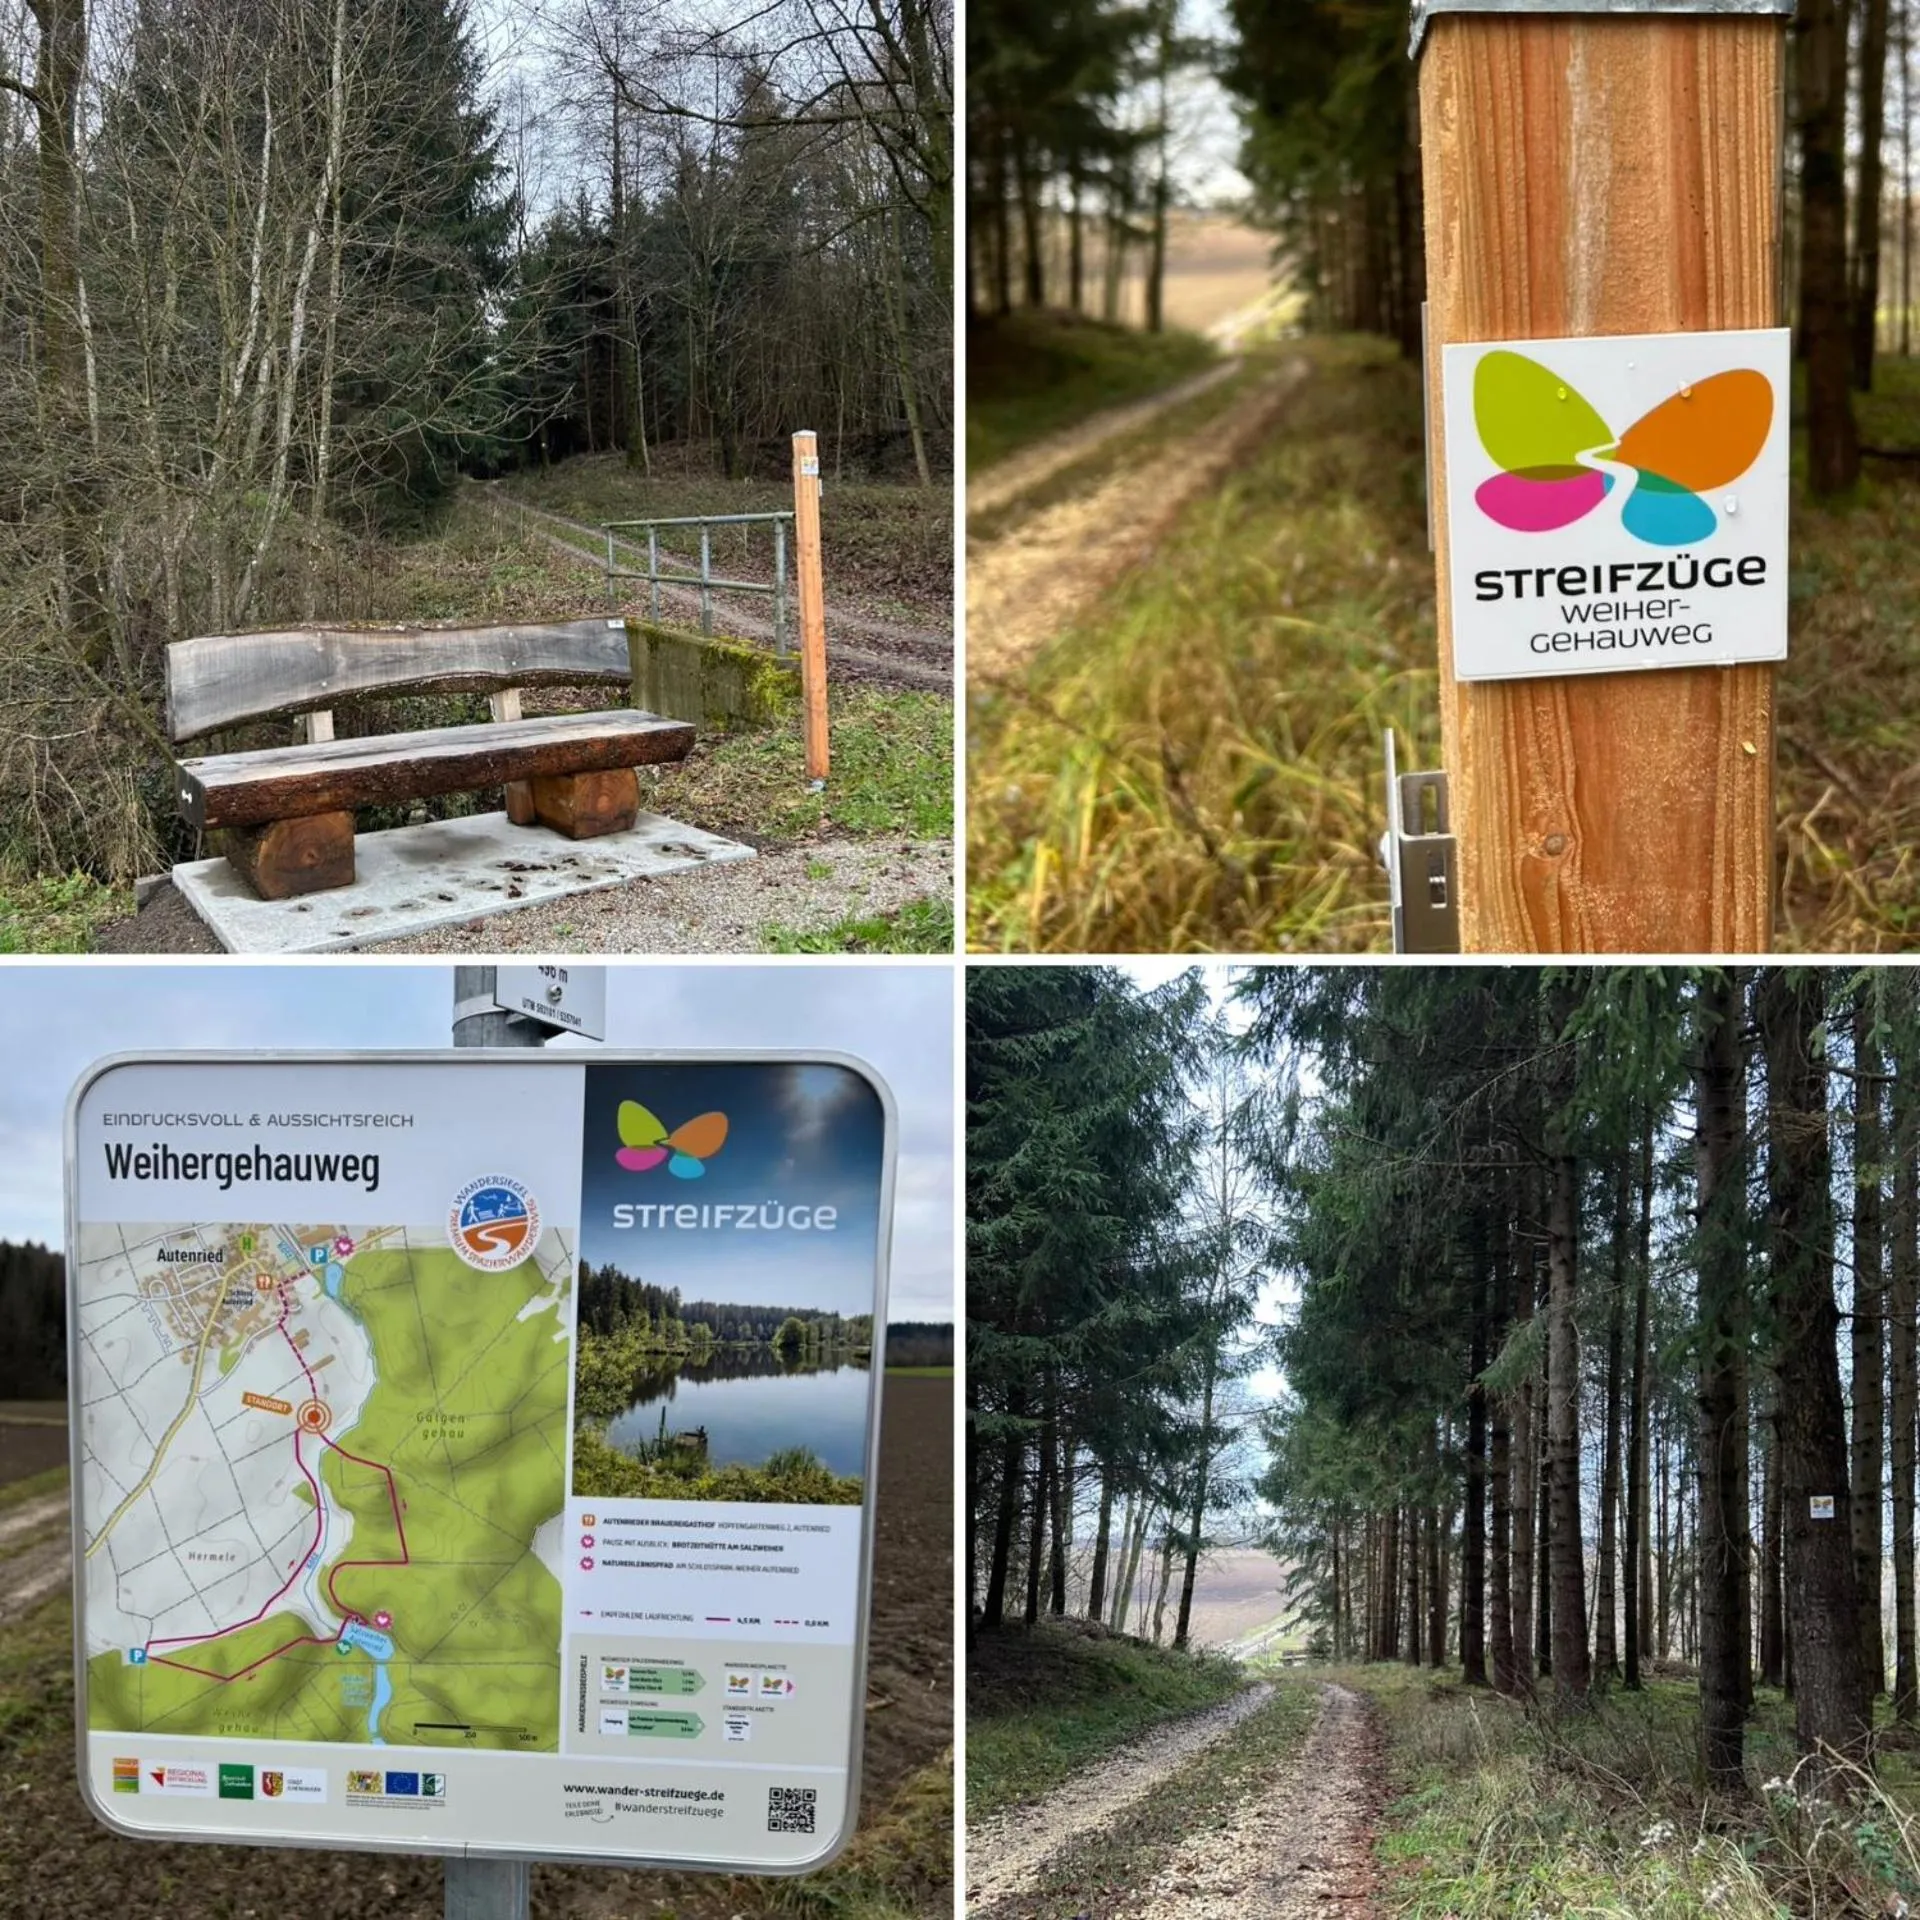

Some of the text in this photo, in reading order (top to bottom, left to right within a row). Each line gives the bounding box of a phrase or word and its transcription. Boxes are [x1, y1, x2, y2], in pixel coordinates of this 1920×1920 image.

[558, 967, 568, 984] m
[249, 1113, 261, 1126] &
[104, 1142, 380, 1192] Weihergehauweg
[454, 1175, 528, 1205] WANDERSIEGEL
[157, 1248, 224, 1263] Autenried
[563, 1783, 725, 1801] www.wander-streifzuege.de
[615, 1802, 724, 1818] #wanderstreifzuege
